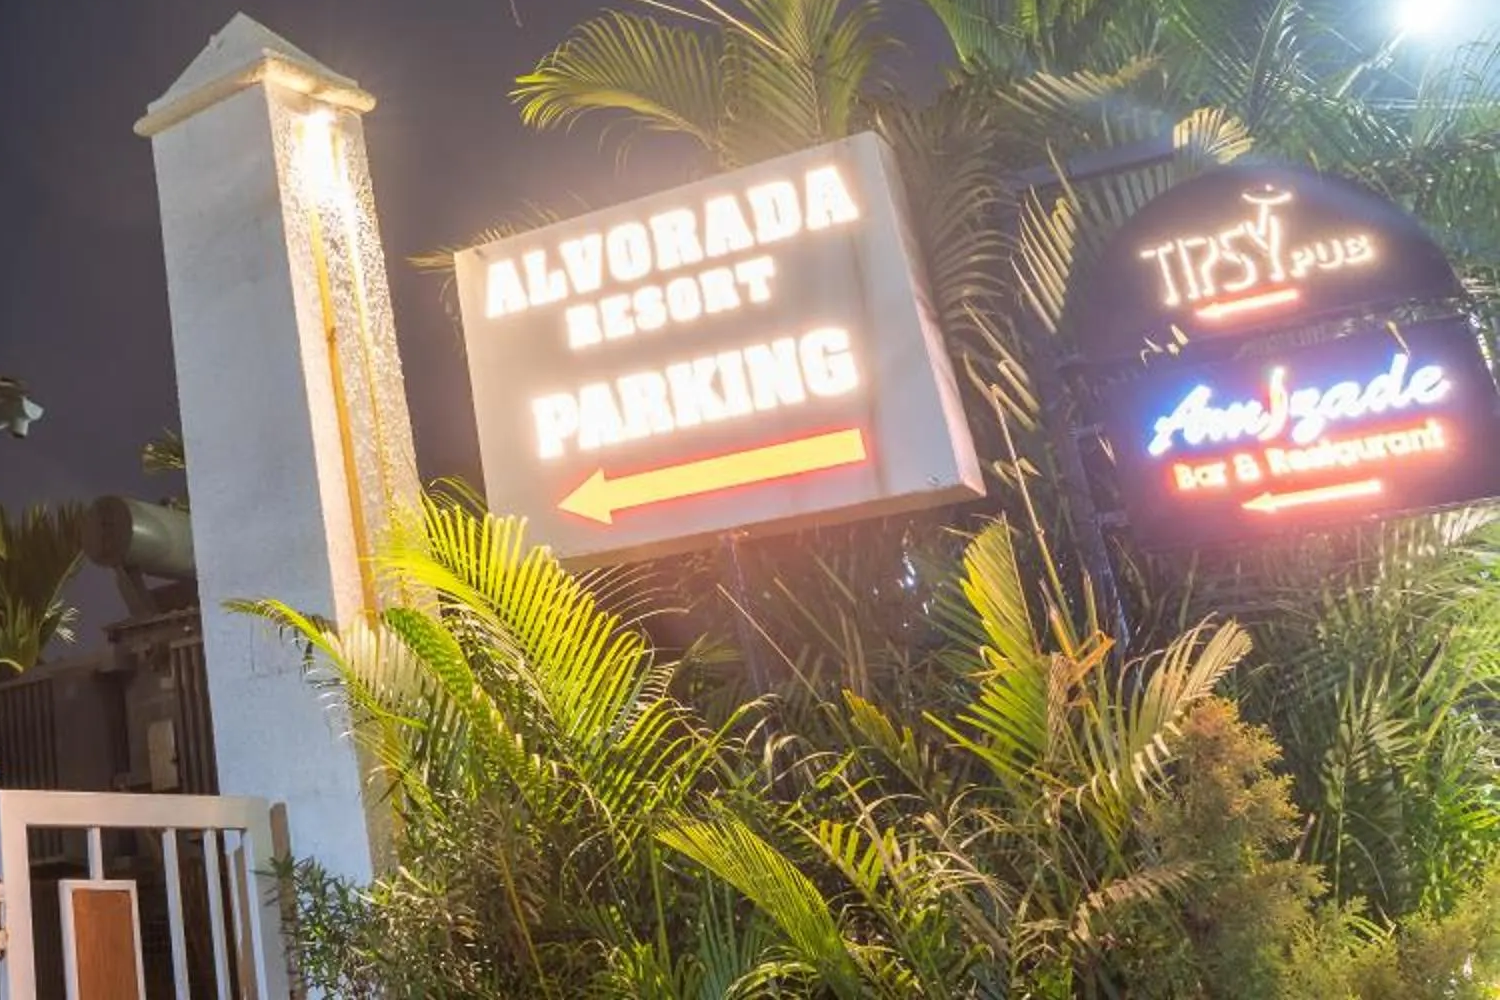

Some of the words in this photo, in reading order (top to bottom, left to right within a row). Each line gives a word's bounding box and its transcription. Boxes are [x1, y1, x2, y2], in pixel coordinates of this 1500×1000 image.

[485, 164, 860, 319] ALVORADA
[565, 255, 776, 350] RESORT
[1140, 184, 1292, 306] TIPSY
[533, 328, 860, 459] PARKING
[1173, 462, 1227, 490] Bar
[1233, 453, 1261, 482] &
[1266, 418, 1446, 476] Restaurant
